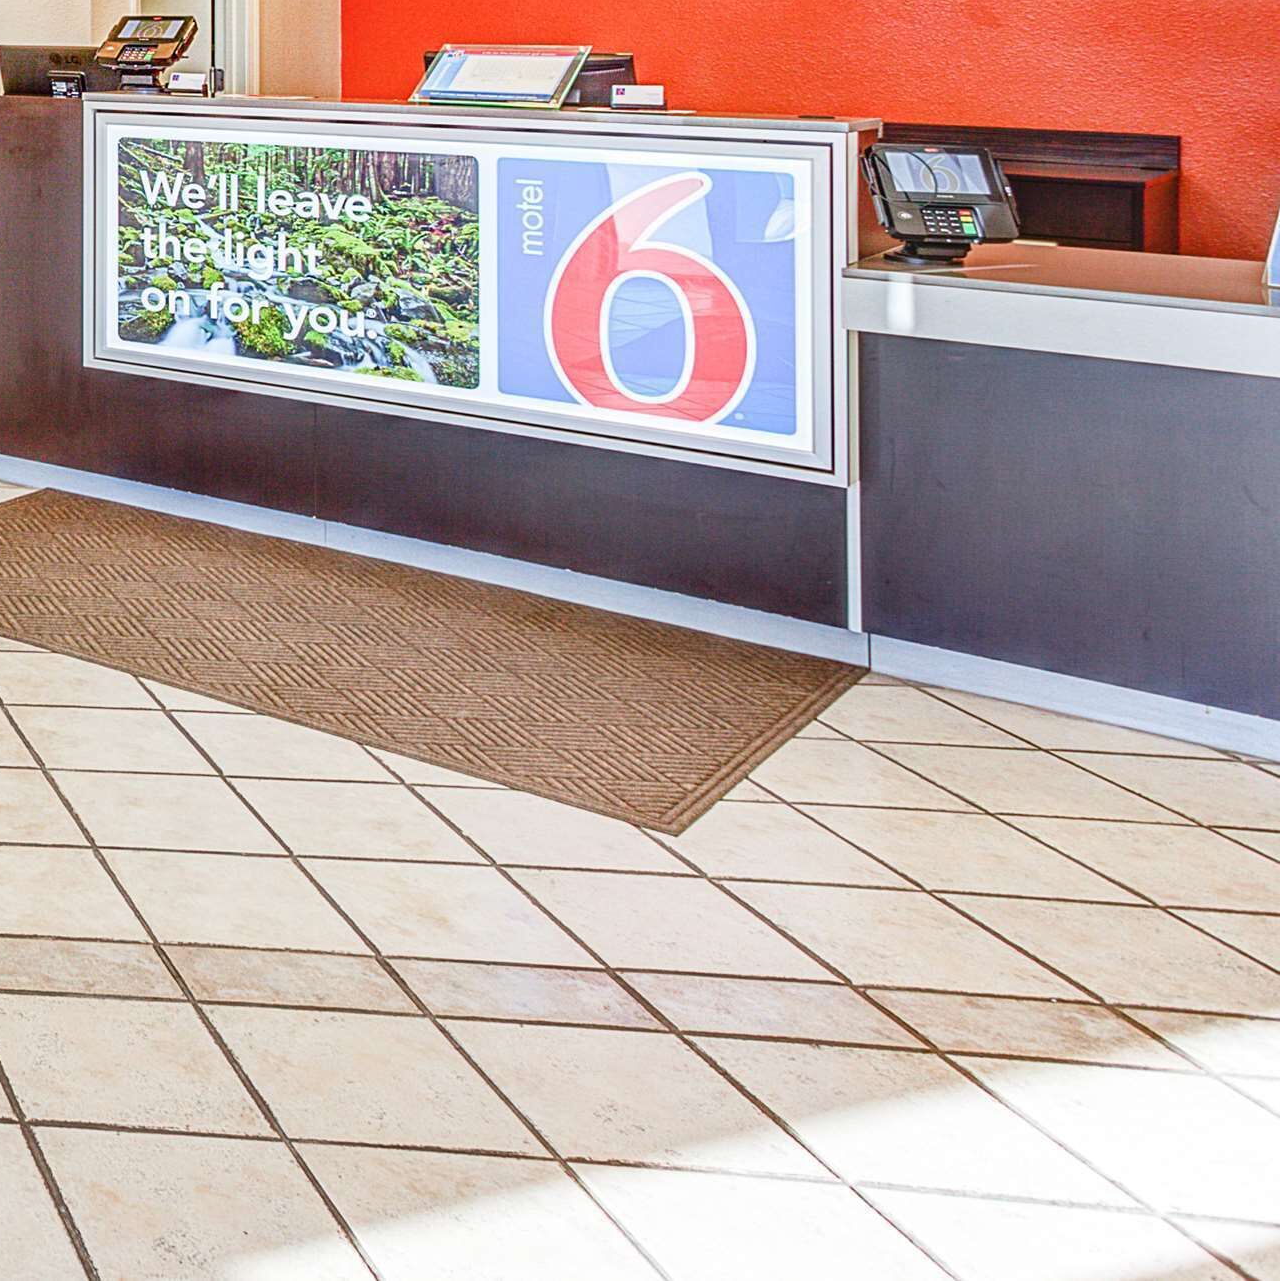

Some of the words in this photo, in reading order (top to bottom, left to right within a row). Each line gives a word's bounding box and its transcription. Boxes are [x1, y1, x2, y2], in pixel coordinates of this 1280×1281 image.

[140, 169, 240, 213] We'll
[256, 175, 373, 223] leave
[514, 178, 545, 256] motel
[140, 219, 208, 264] the
[224, 227, 323, 281] light
[140, 286, 191, 317] on
[206, 281, 269, 326] for
[543, 170, 758, 425] 6
